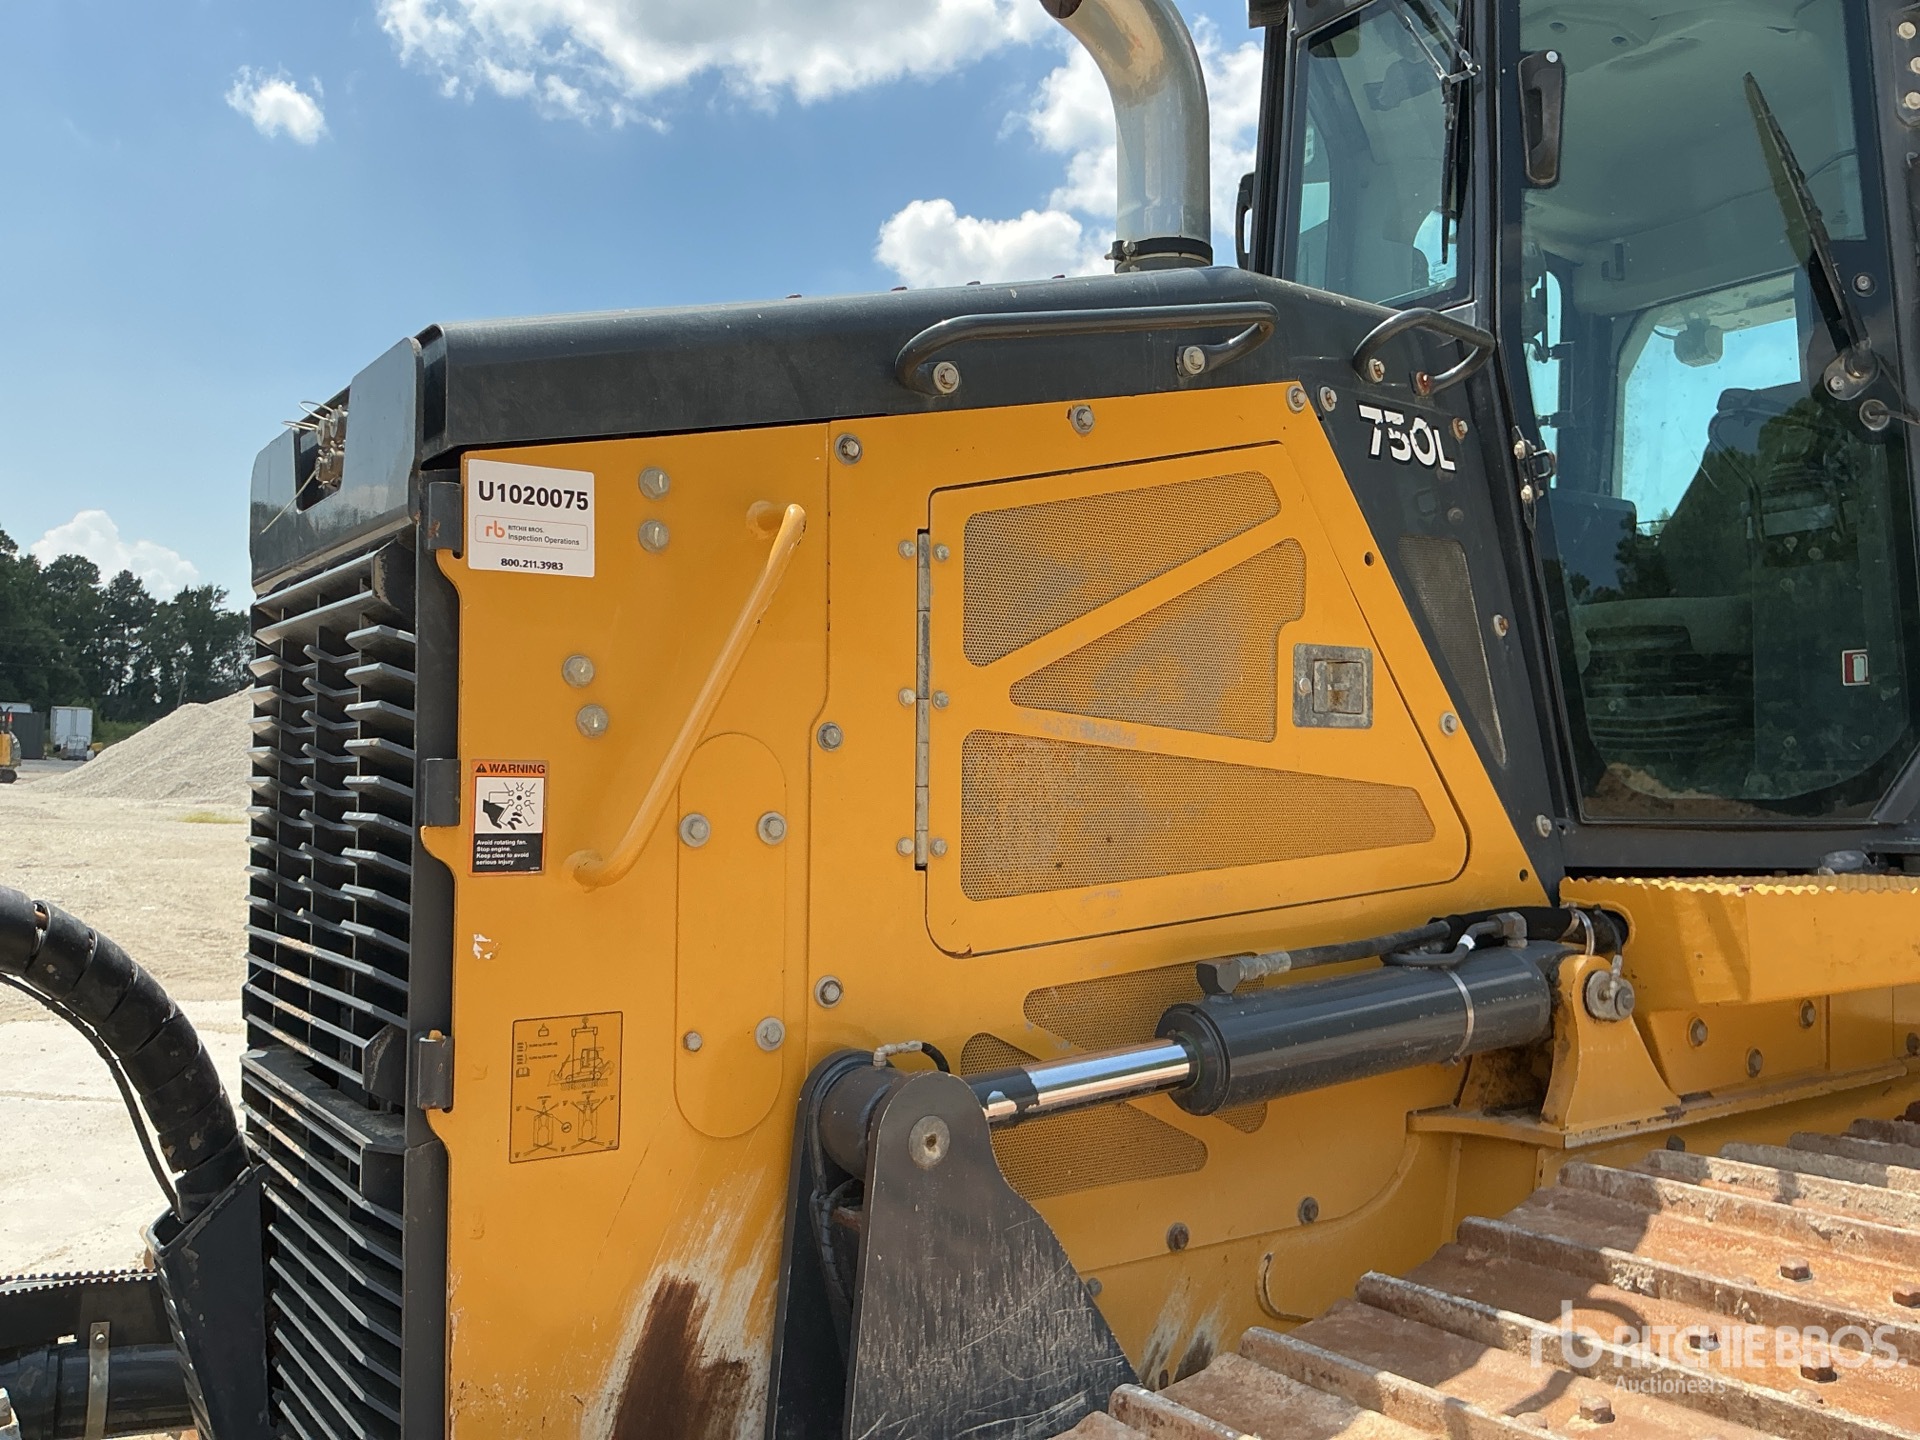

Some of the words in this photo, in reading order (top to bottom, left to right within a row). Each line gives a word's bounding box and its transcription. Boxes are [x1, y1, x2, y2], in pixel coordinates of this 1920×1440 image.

[1358, 404, 1456, 471] 750L
[478, 480, 589, 511] U1020075
[485, 520, 505, 538] rb
[508, 533, 543, 543] Inspection
[544, 536, 580, 546] Operations
[500, 558, 563, 571] 800.211.3983
[489, 763, 546, 774] WARNING
